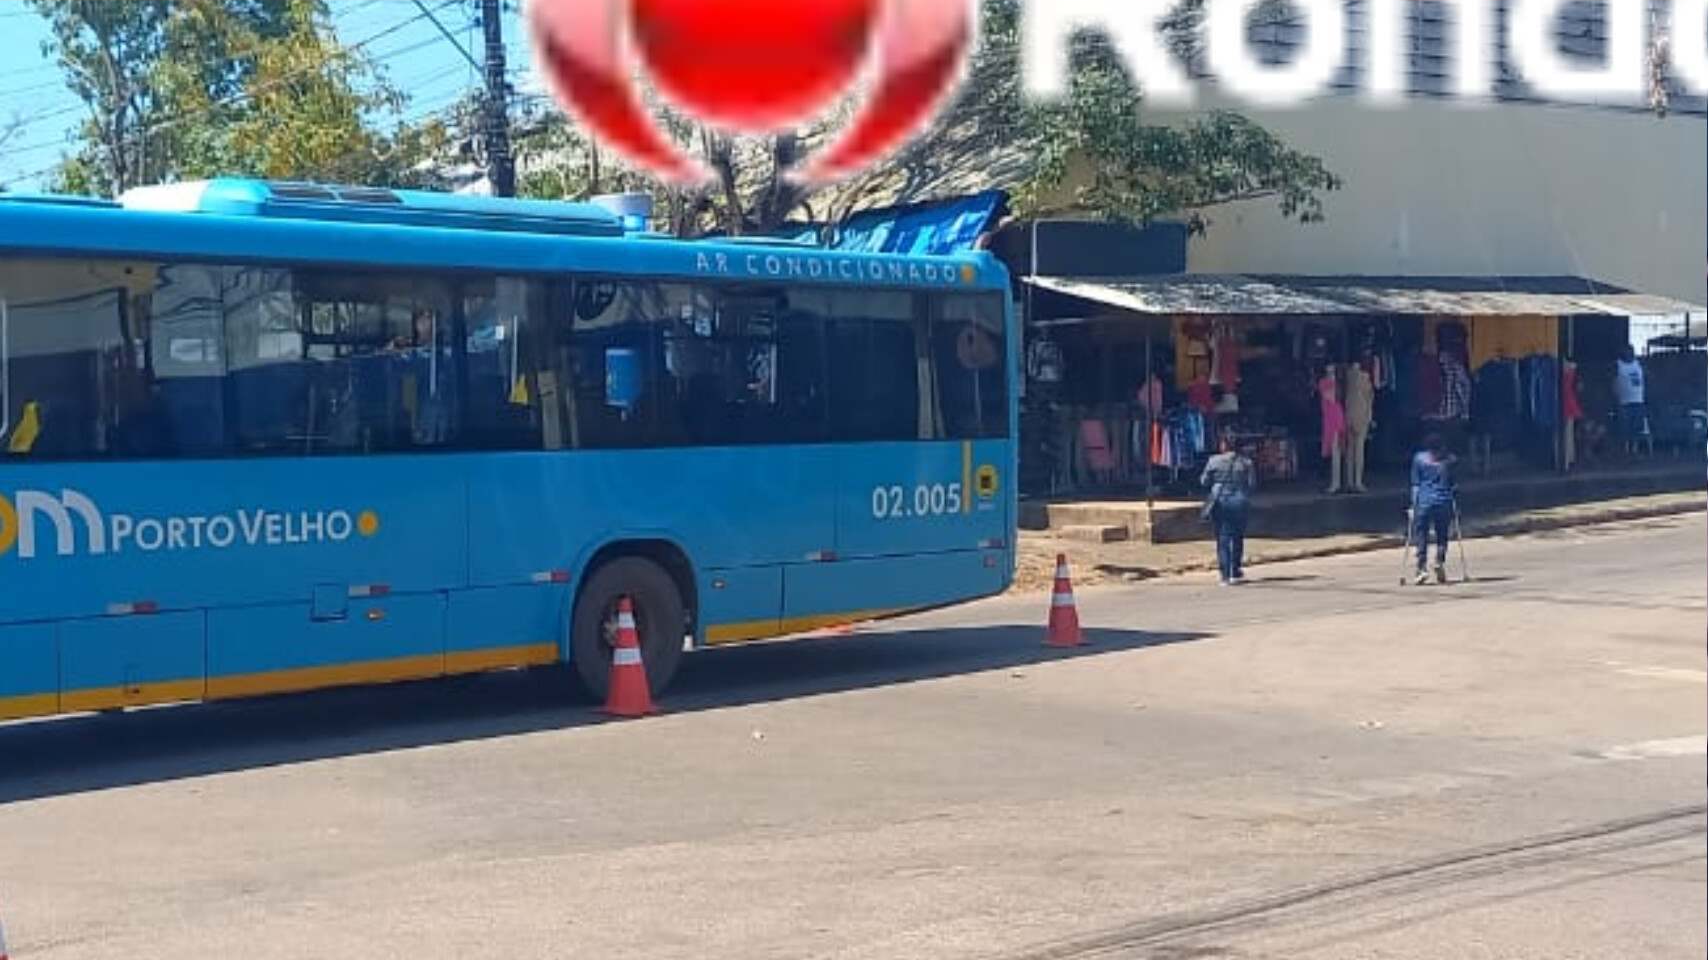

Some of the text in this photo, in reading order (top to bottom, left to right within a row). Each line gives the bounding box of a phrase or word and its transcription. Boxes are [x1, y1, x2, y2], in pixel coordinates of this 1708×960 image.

[697, 252, 956, 282] AR CONDICIONADO
[872, 483, 961, 518] 02.005
